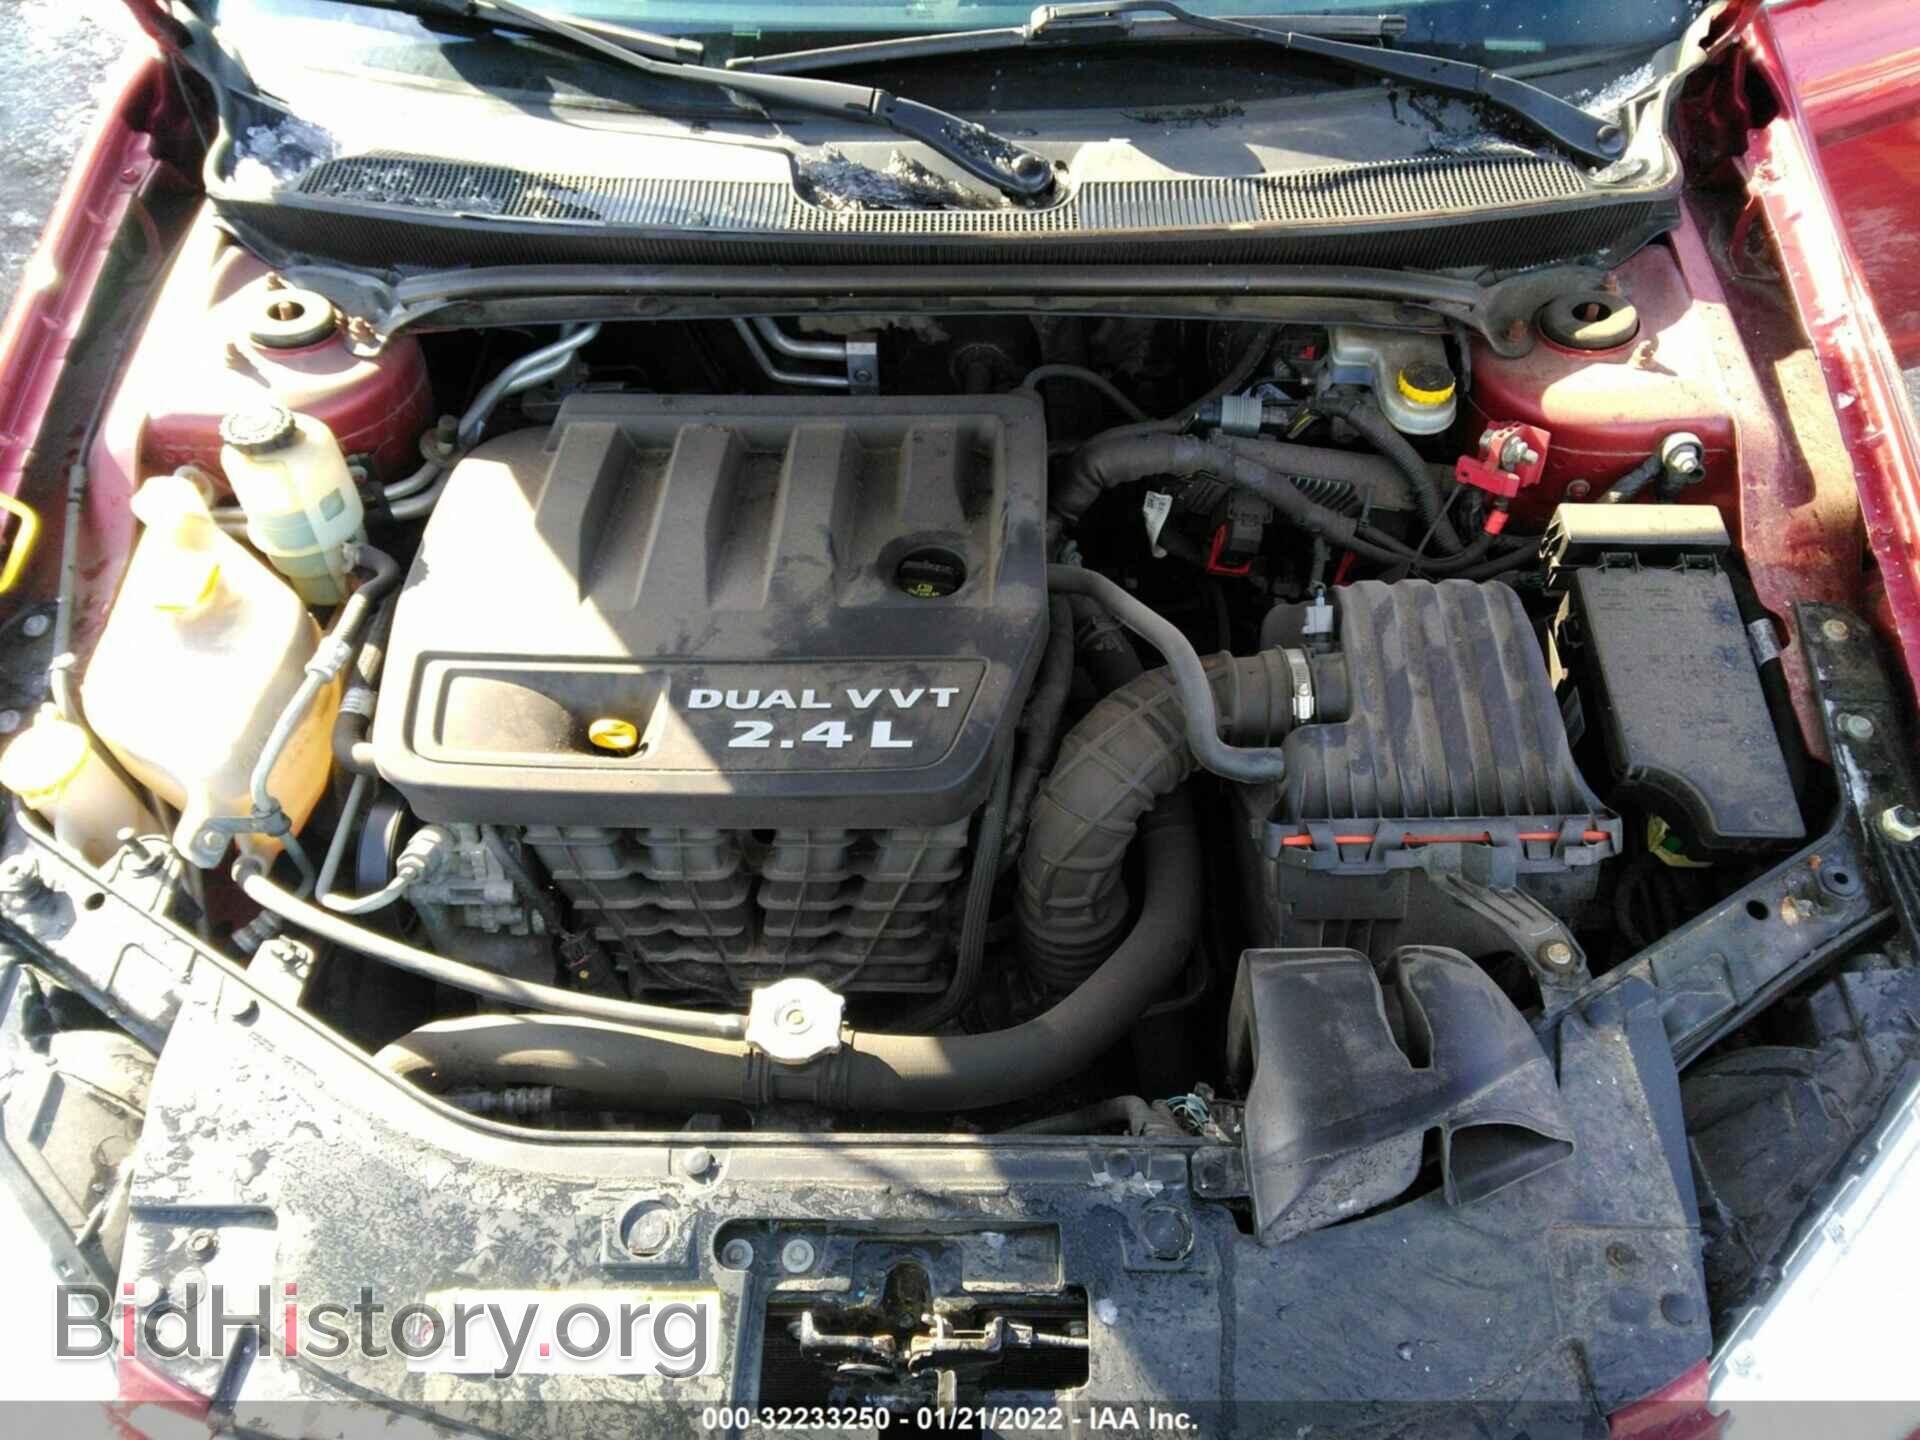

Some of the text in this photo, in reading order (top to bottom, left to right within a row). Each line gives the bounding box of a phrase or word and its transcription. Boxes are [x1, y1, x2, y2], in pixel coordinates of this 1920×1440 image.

[688, 688, 960, 709] DUAL VVT
[728, 721, 913, 748] 2.4 L
